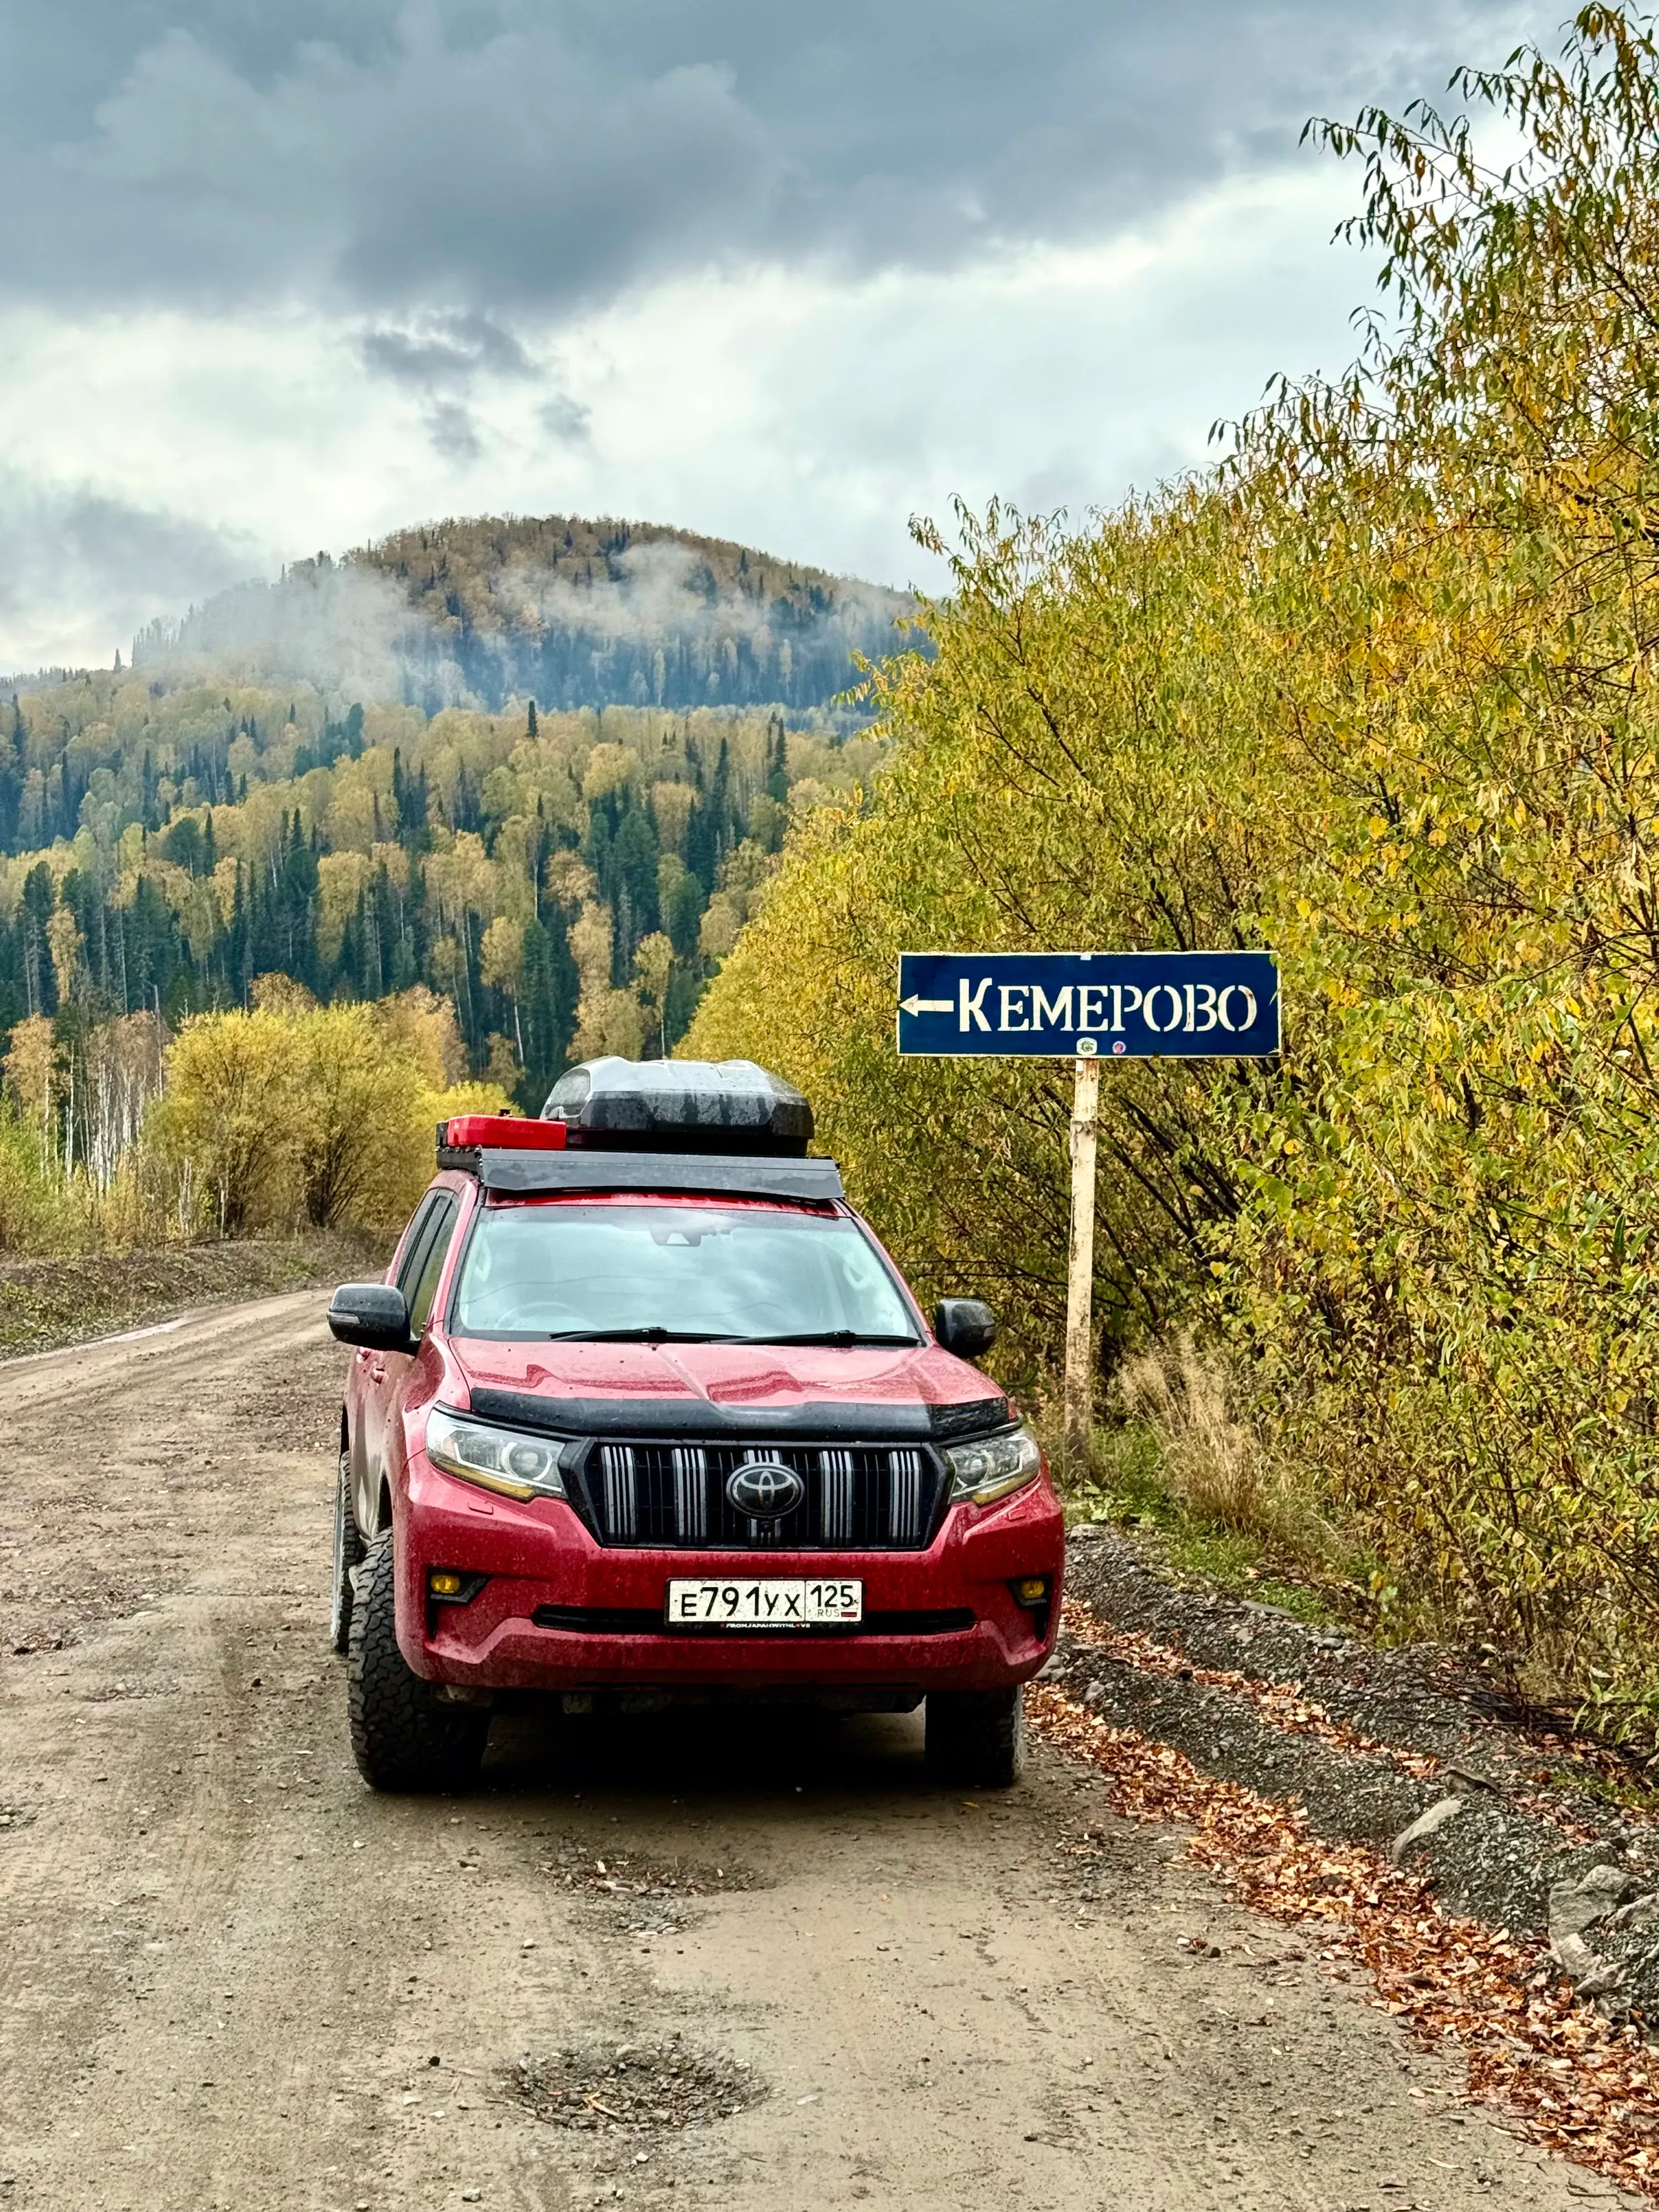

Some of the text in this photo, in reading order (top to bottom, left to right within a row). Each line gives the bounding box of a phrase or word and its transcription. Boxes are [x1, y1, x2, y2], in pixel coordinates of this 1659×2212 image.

[958, 978, 1257, 1032] КЕМЕРОВО
[810, 1585, 853, 1607] 125
[817, 1609, 840, 1617] RUS
